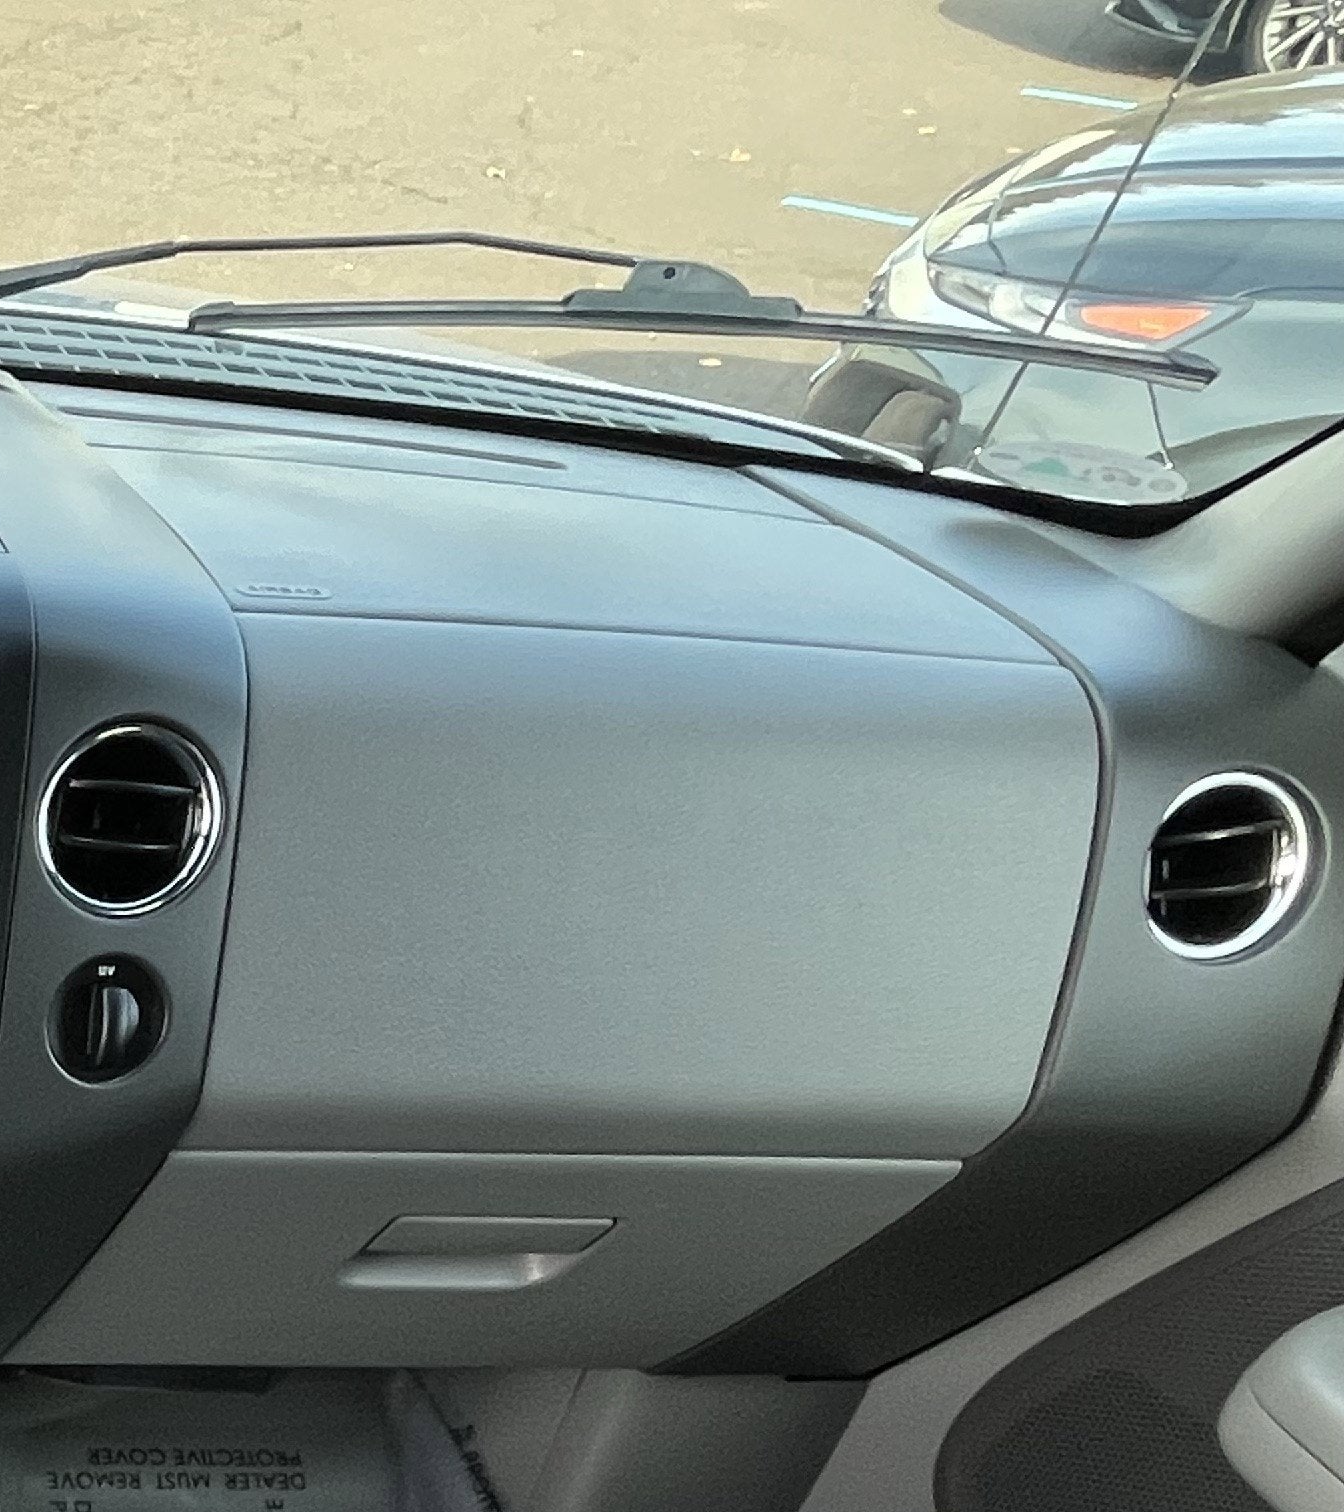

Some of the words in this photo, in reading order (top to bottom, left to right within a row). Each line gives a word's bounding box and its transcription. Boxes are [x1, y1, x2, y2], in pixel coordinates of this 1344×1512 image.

[87, 1448, 167, 1467] COVER
[174, 1449, 303, 1468] PROTECTIVE
[46, 1470, 142, 1491] REMOVE
[155, 1471, 210, 1490] MUST
[224, 1471, 307, 1492] DEALER
